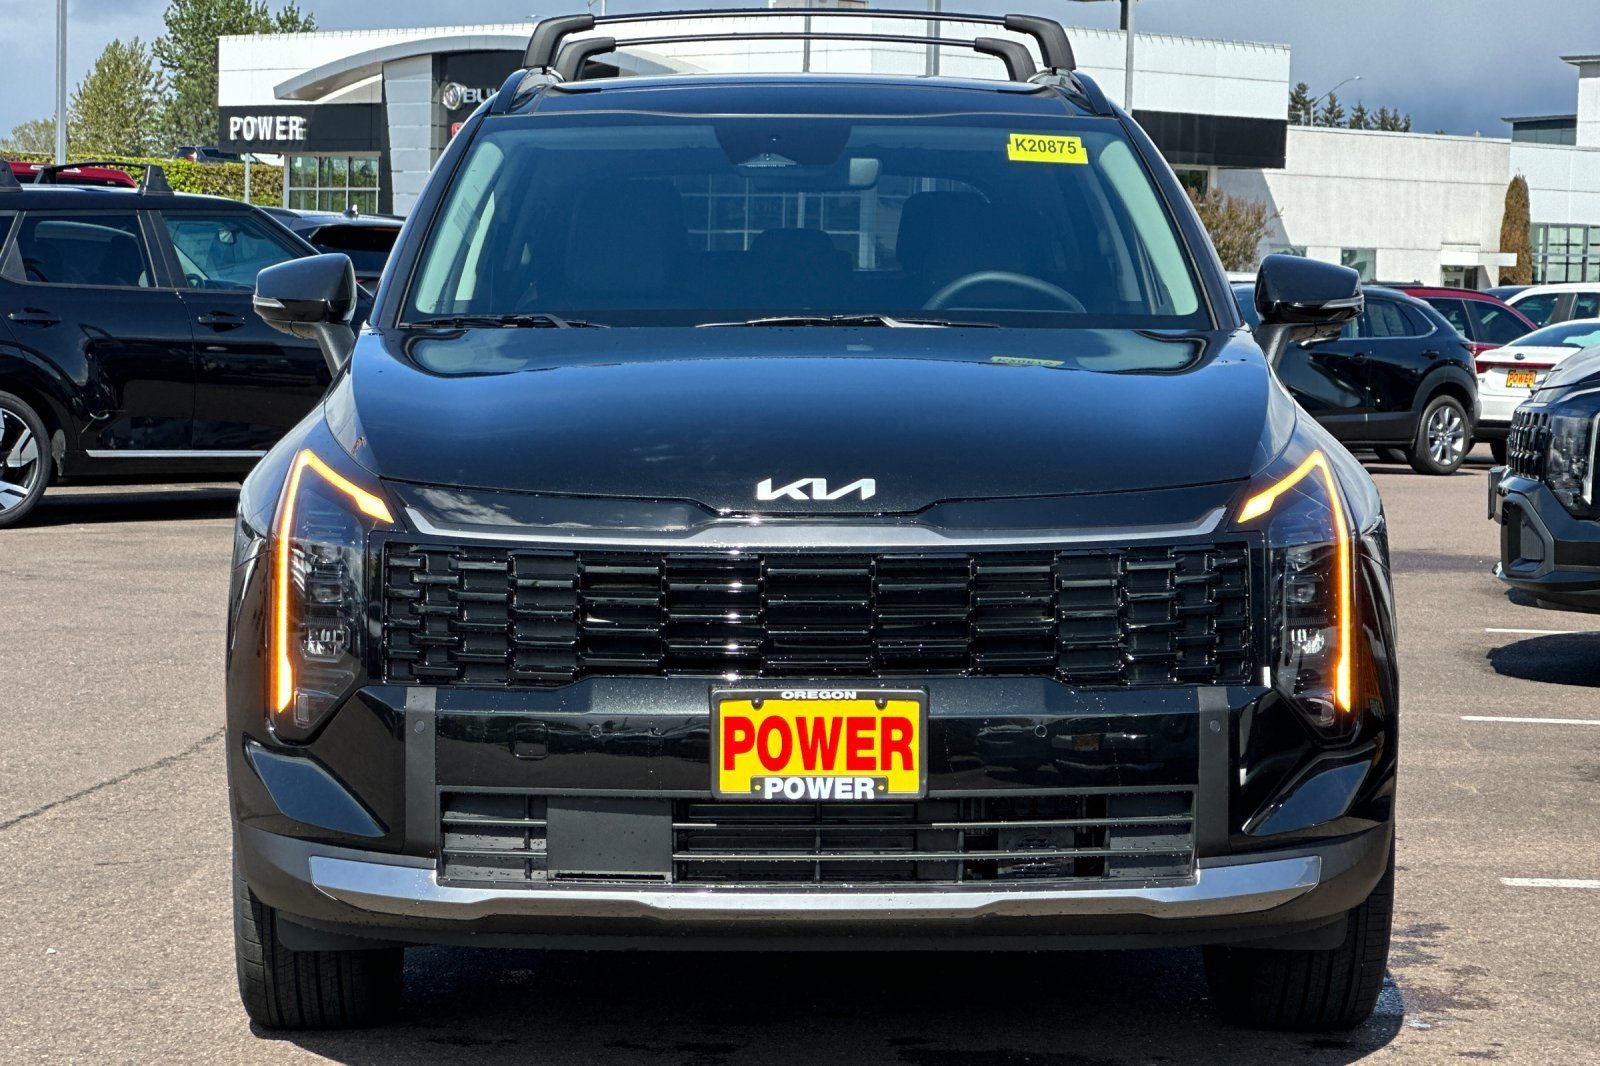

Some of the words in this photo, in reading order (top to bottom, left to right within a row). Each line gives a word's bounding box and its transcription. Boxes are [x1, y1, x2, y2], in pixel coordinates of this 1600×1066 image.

[229, 116, 306, 141] POWER
[1014, 138, 1077, 154] K20875
[1509, 373, 1534, 384] POWER
[757, 478, 876, 500] KIA
[781, 690, 857, 700] OREGON
[723, 715, 914, 771] POWER
[763, 777, 875, 800] POWER
